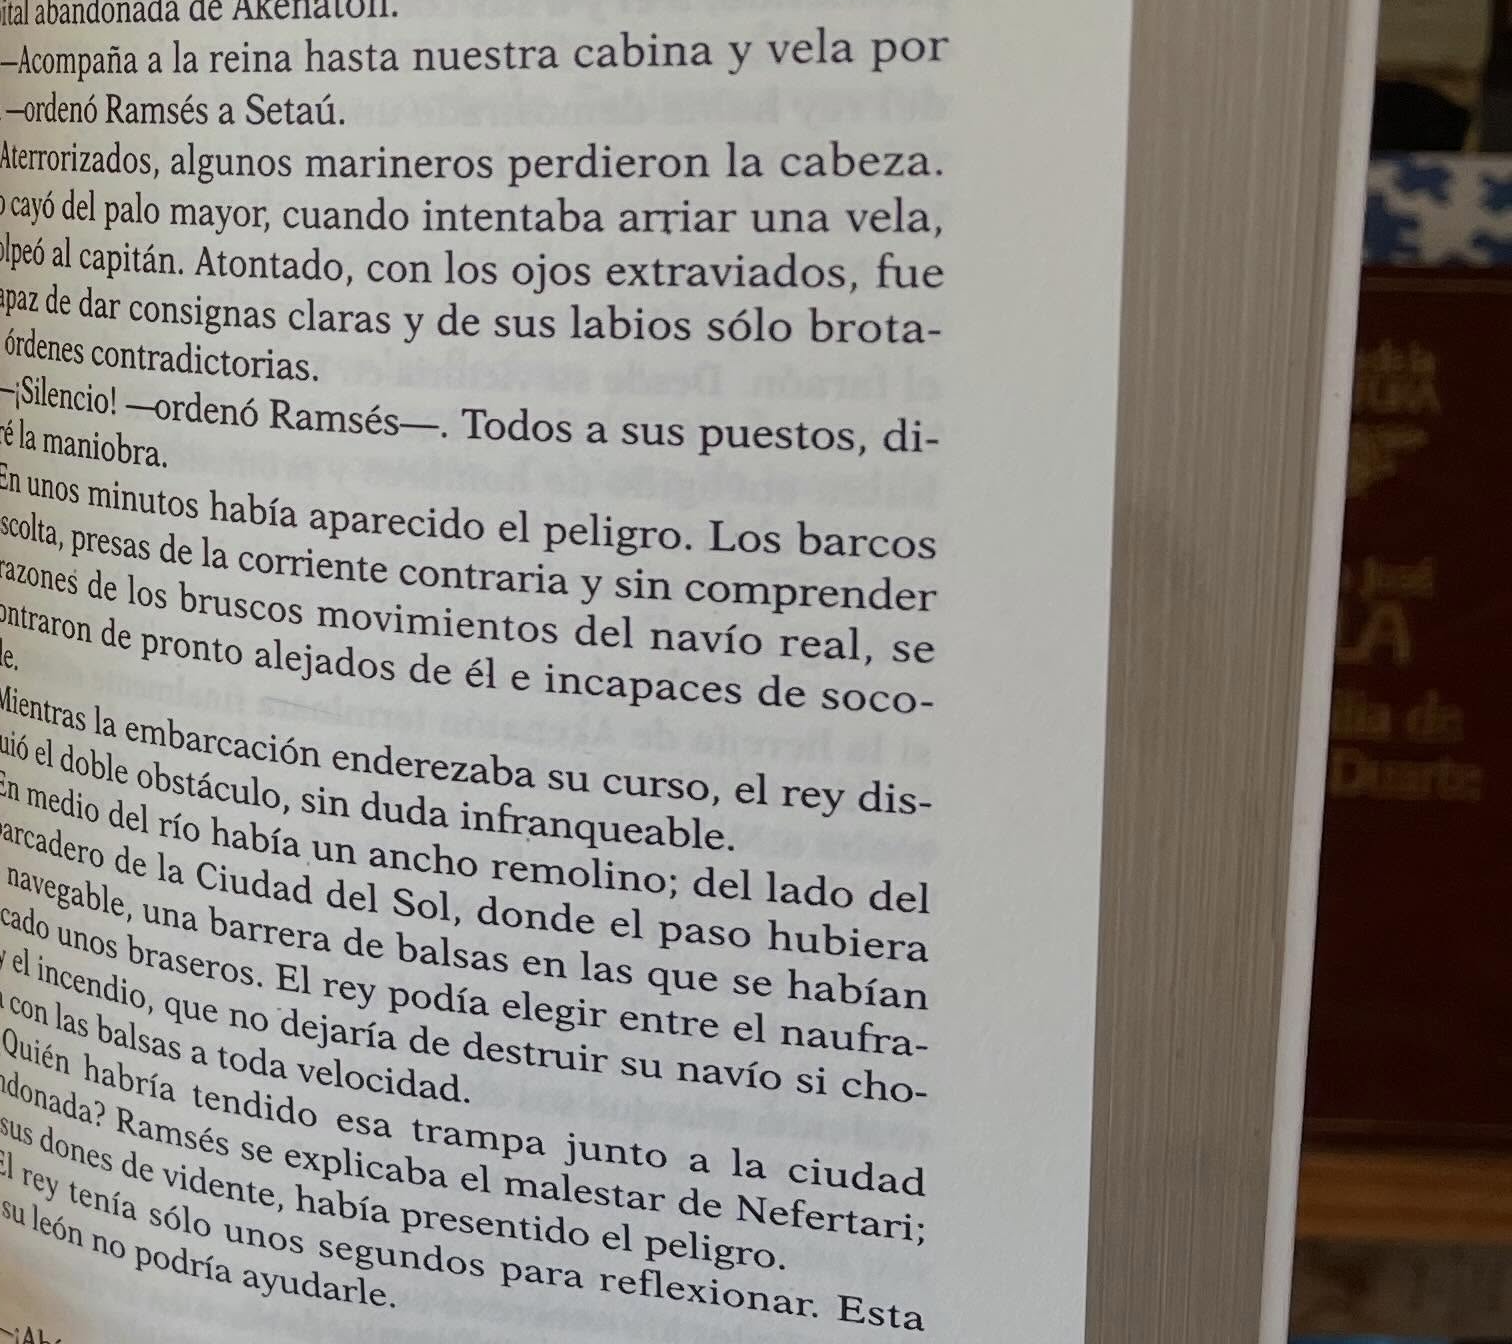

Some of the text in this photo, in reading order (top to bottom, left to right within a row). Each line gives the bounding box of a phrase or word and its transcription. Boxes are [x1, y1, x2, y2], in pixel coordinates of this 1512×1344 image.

[104, 92, 209, 126] Ramsés
[218, 102, 236, 126] a
[245, 92, 345, 126] Setaú.
[4, 327, 85, 365] órdenes
[91, 341, 319, 383] contradictorias.
[19, 417, 37, 452] la
[42, 431, 168, 469] maniobra.
[26, 475, 80, 504] unos
[87, 480, 199, 519] minutos
[208, 488, 299, 529] había
[309, 506, 485, 541] aparecido
[498, 509, 531, 544] el
[542, 512, 693, 557] peligro.
[708, 519, 782, 555] Los
[796, 519, 937, 561] barcos
[34, 737, 54, 769] el
[59, 743, 129, 785] doble
[136, 760, 290, 816] obstáculo,
[300, 786, 351, 818] sin
[360, 790, 450, 829] duda
[459, 800, 735, 852] infranqueable.
[9, 995, 49, 1026] con
[55, 1000, 89, 1038] las
[96, 1014, 183, 1060] balsas
[190, 1045, 209, 1066] a
[216, 1045, 289, 1080] toda
[296, 1057, 471, 1104] velocidad.
[1, 1200, 26, 1227] su
[31, 1202, 84, 1248] león
[91, 1233, 126, 1259] no
[134, 1245, 233, 1284] podría
[242, 1267, 397, 1308] ayudarle.
